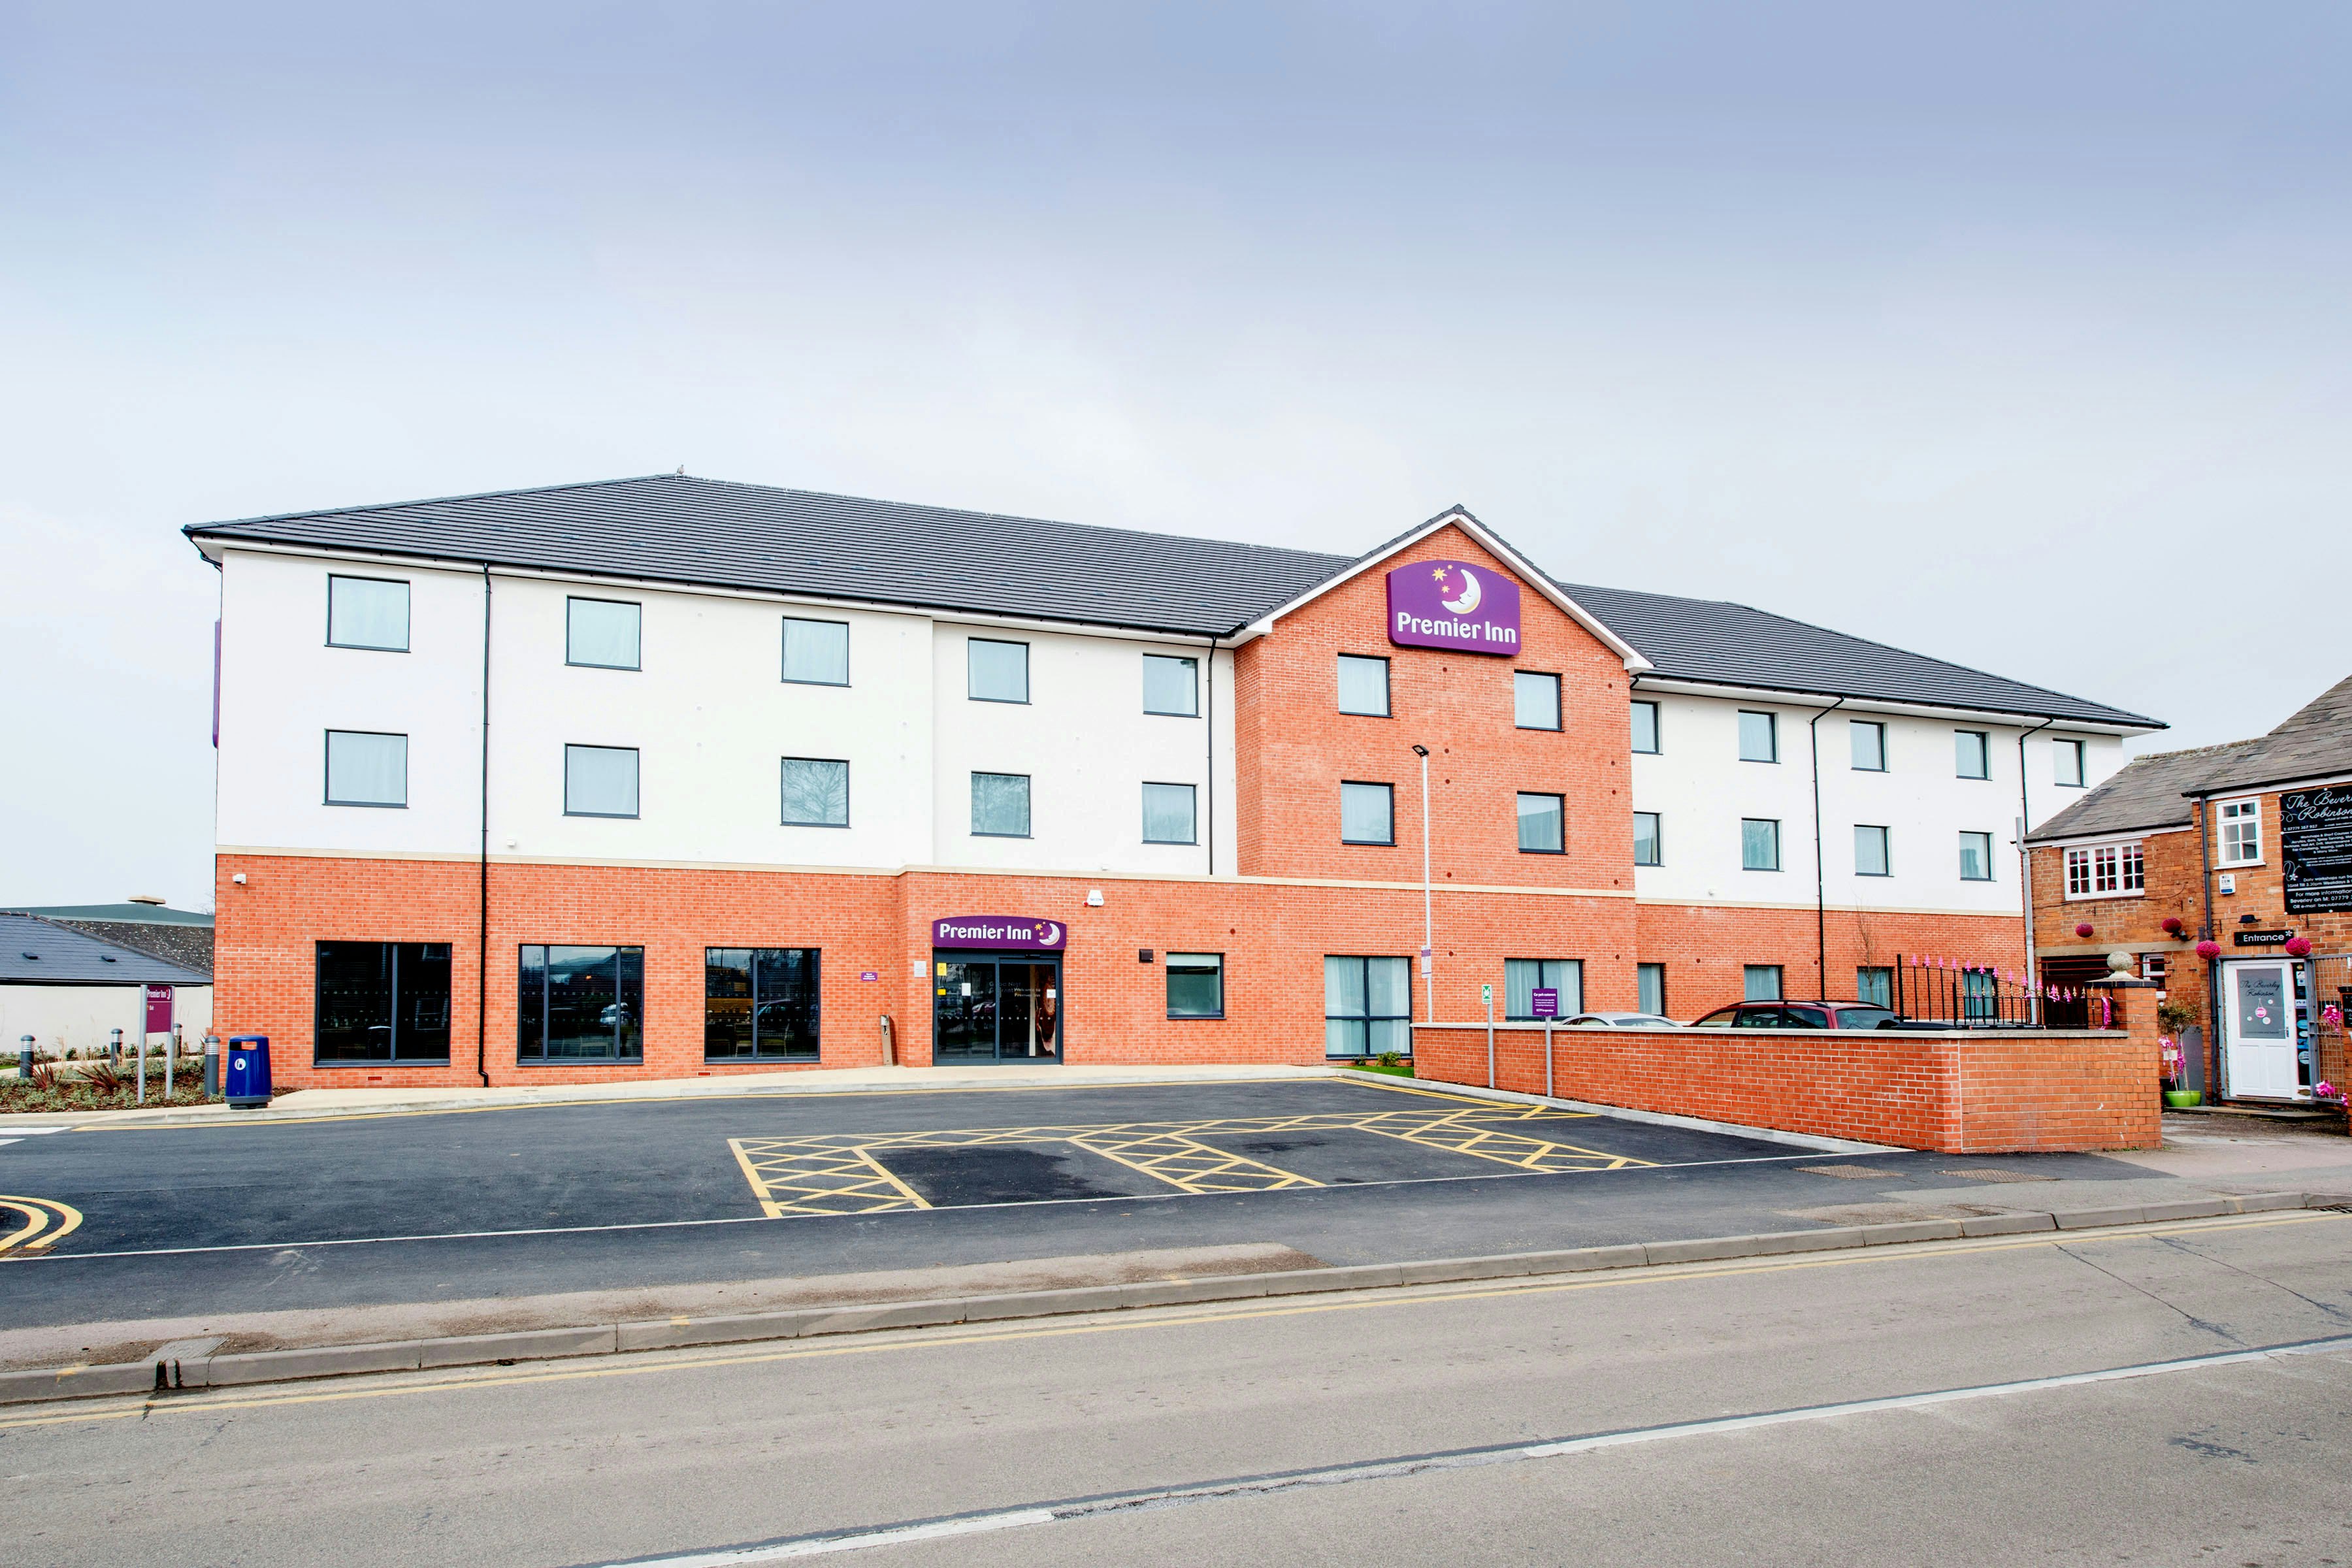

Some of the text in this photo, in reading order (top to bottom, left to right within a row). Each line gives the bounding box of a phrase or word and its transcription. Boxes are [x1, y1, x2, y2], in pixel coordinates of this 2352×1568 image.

[1397, 612, 1516, 644] Premier Inn
[2287, 794, 2310, 809] The
[939, 923, 1032, 940] Premier Inn
